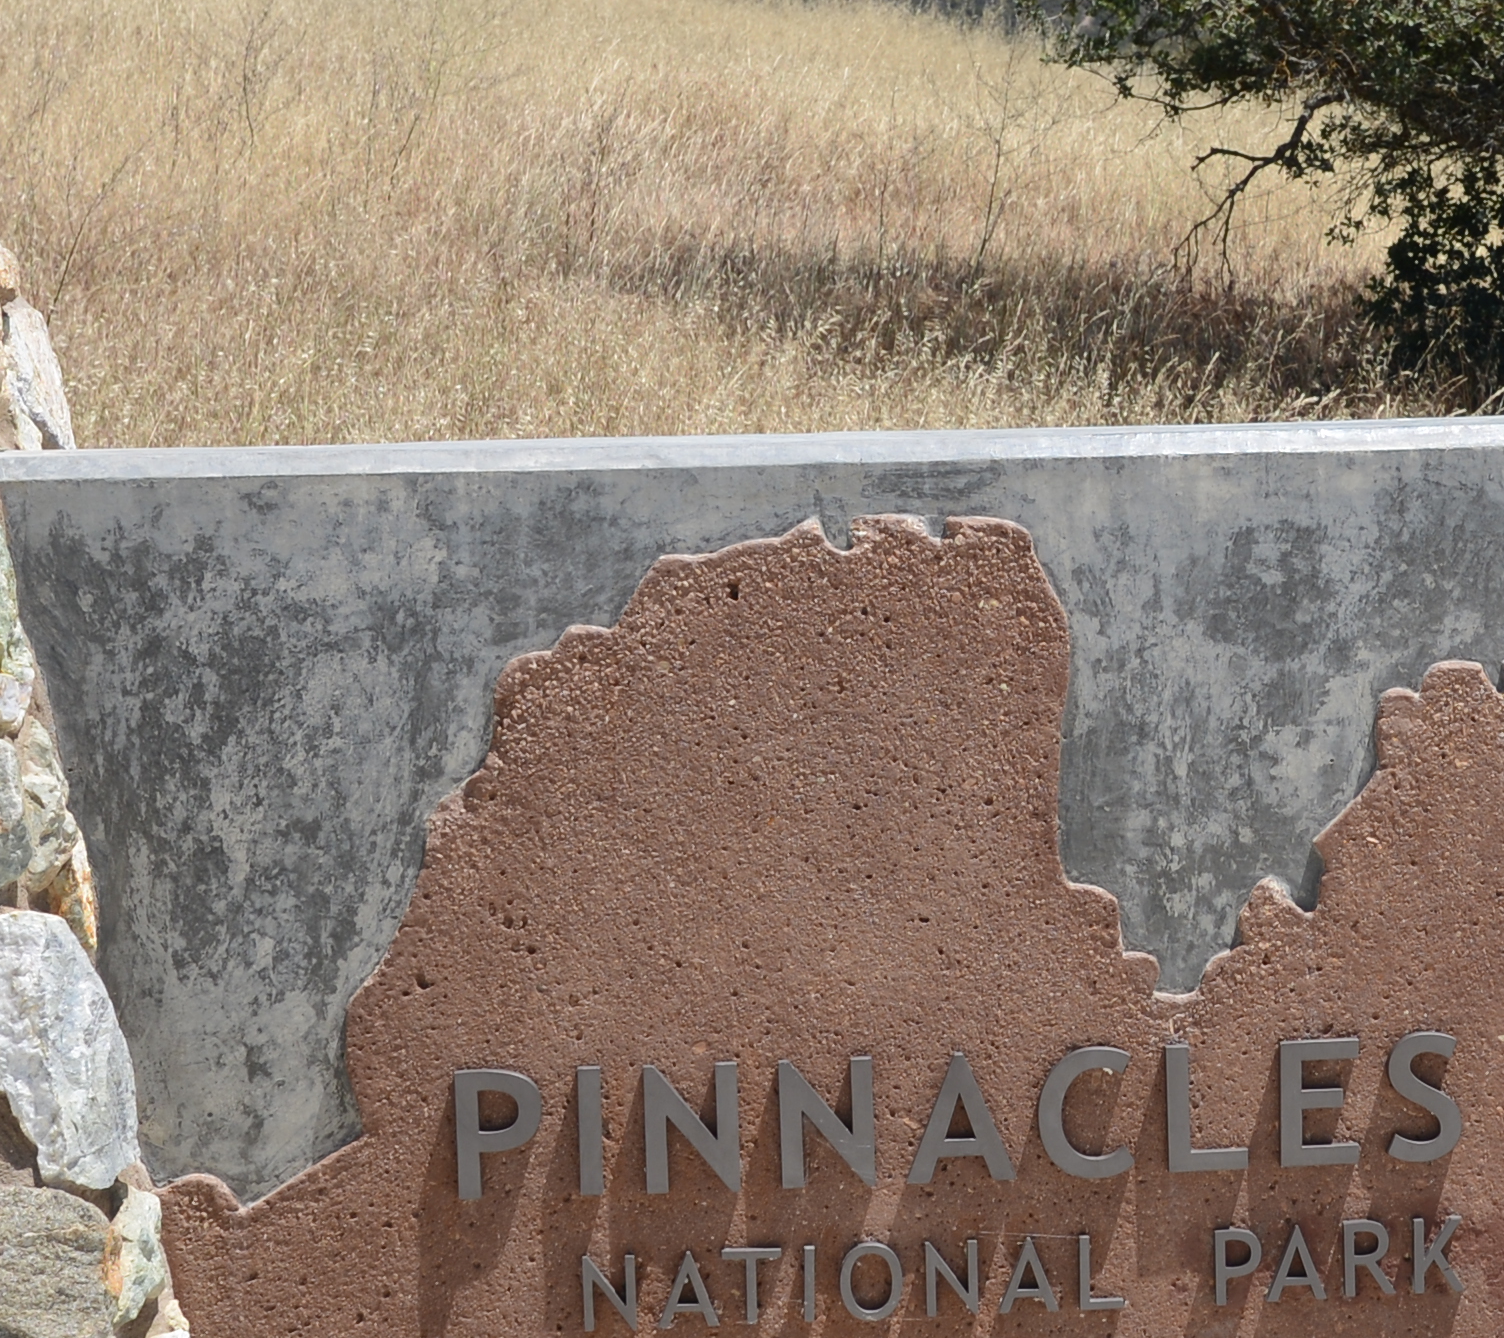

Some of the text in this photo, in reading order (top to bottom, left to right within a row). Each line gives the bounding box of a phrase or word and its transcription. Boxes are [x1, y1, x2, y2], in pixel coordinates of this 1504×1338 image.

[454, 1031, 1463, 1200] PINNACLES
[582, 1214, 1465, 1332] NATIONAL PARK
